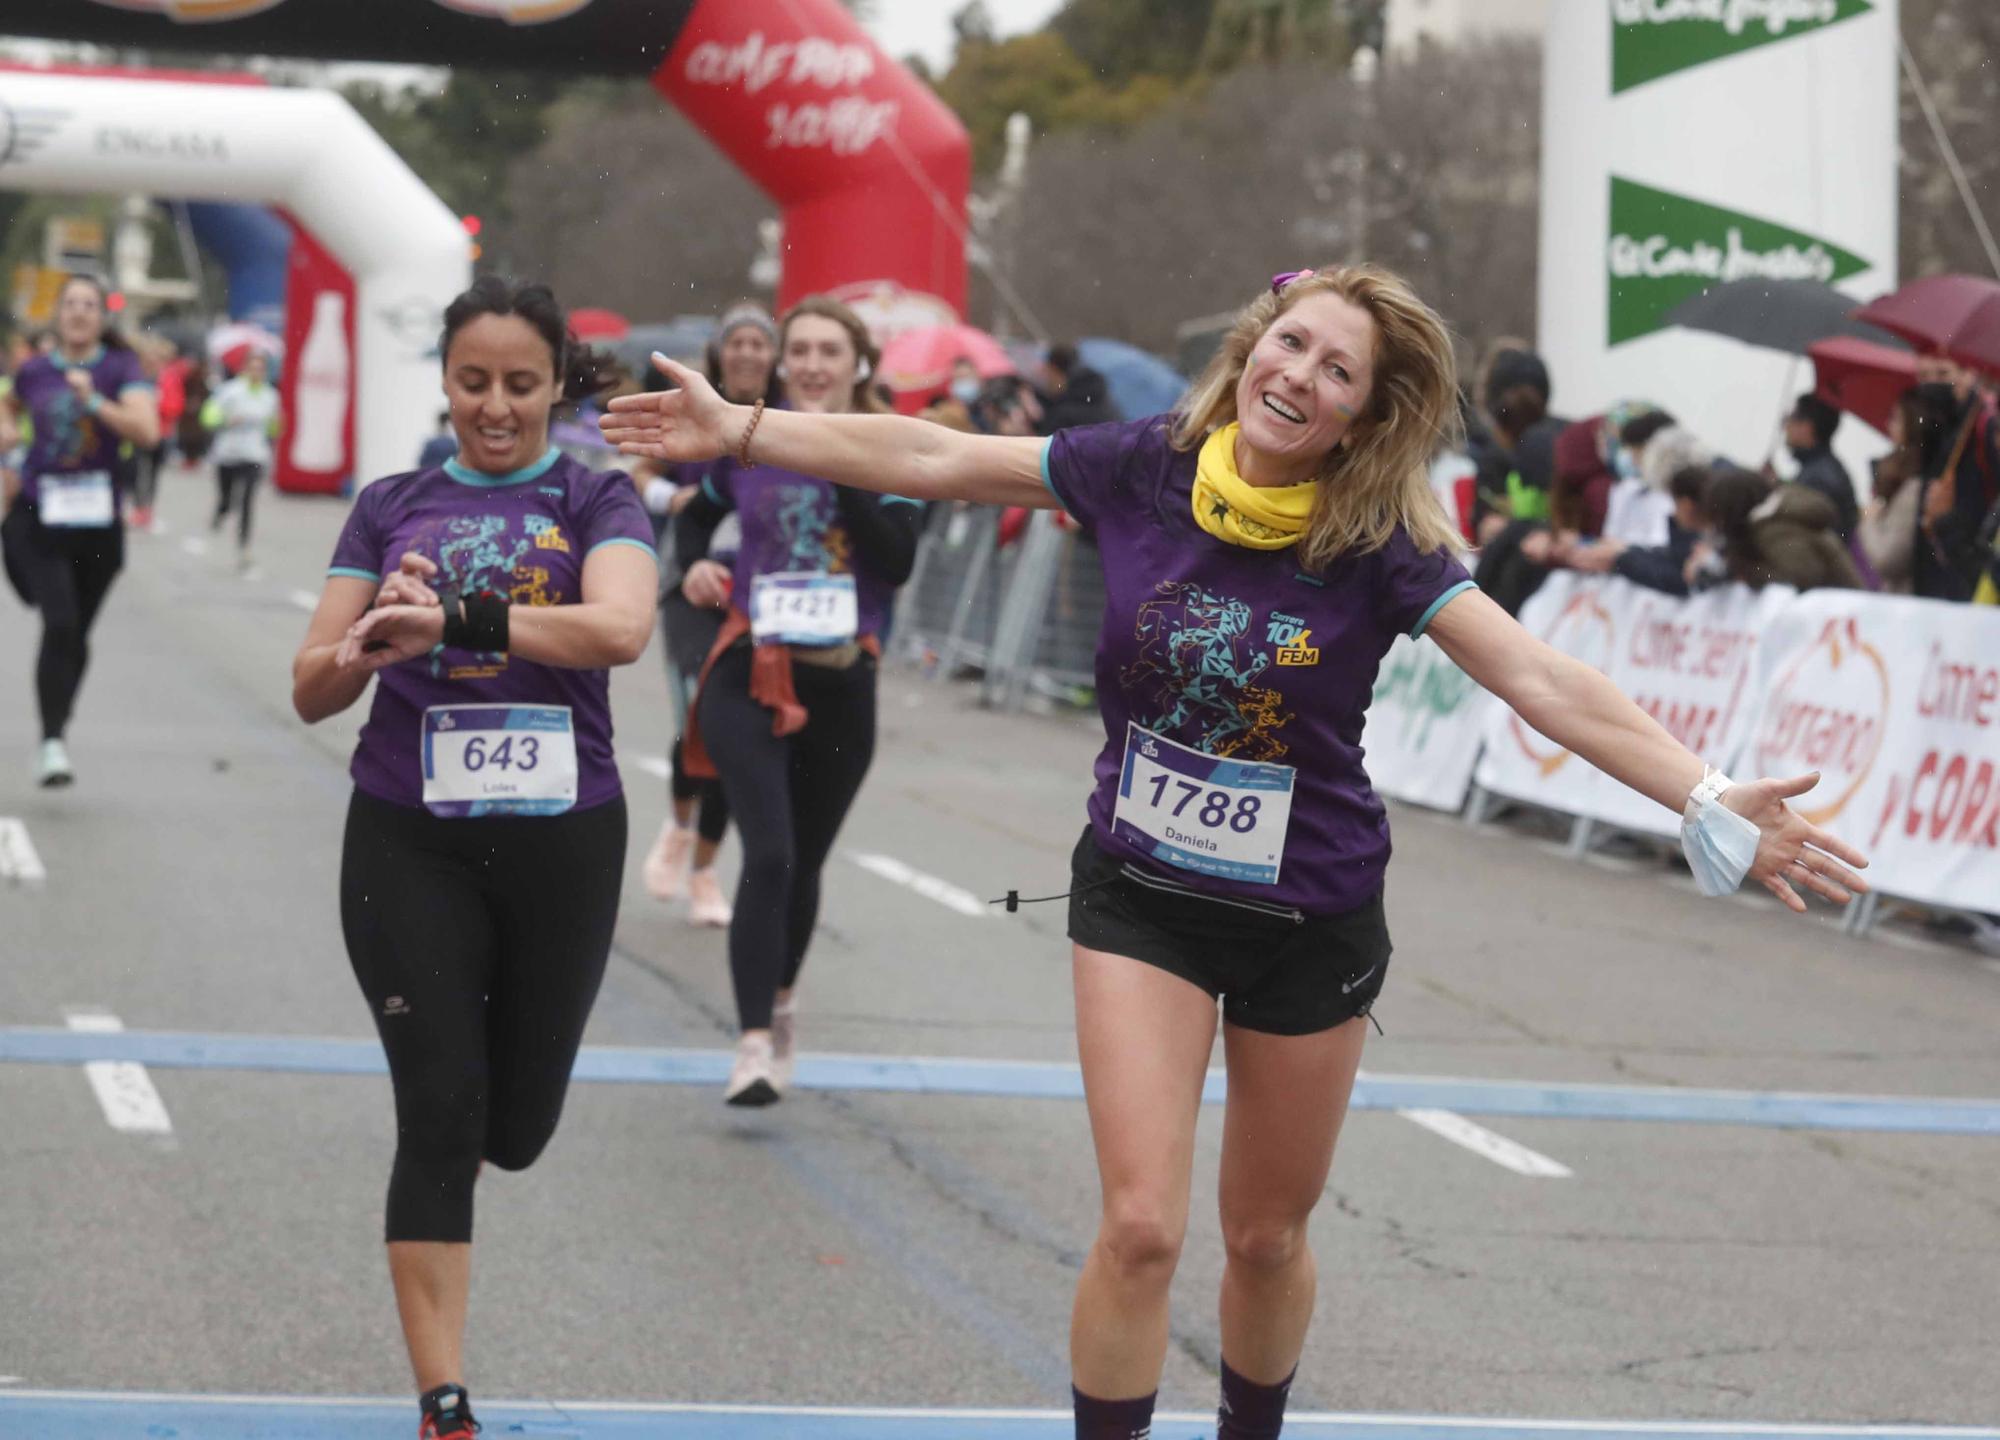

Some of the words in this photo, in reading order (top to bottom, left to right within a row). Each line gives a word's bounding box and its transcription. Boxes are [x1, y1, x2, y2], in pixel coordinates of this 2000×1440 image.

[1266, 621, 1312, 648] 10K
[1279, 649, 1317, 664] FEM
[463, 736, 540, 772] 643
[1149, 774, 1262, 834] 1788
[1165, 826, 1218, 852] Daniela
